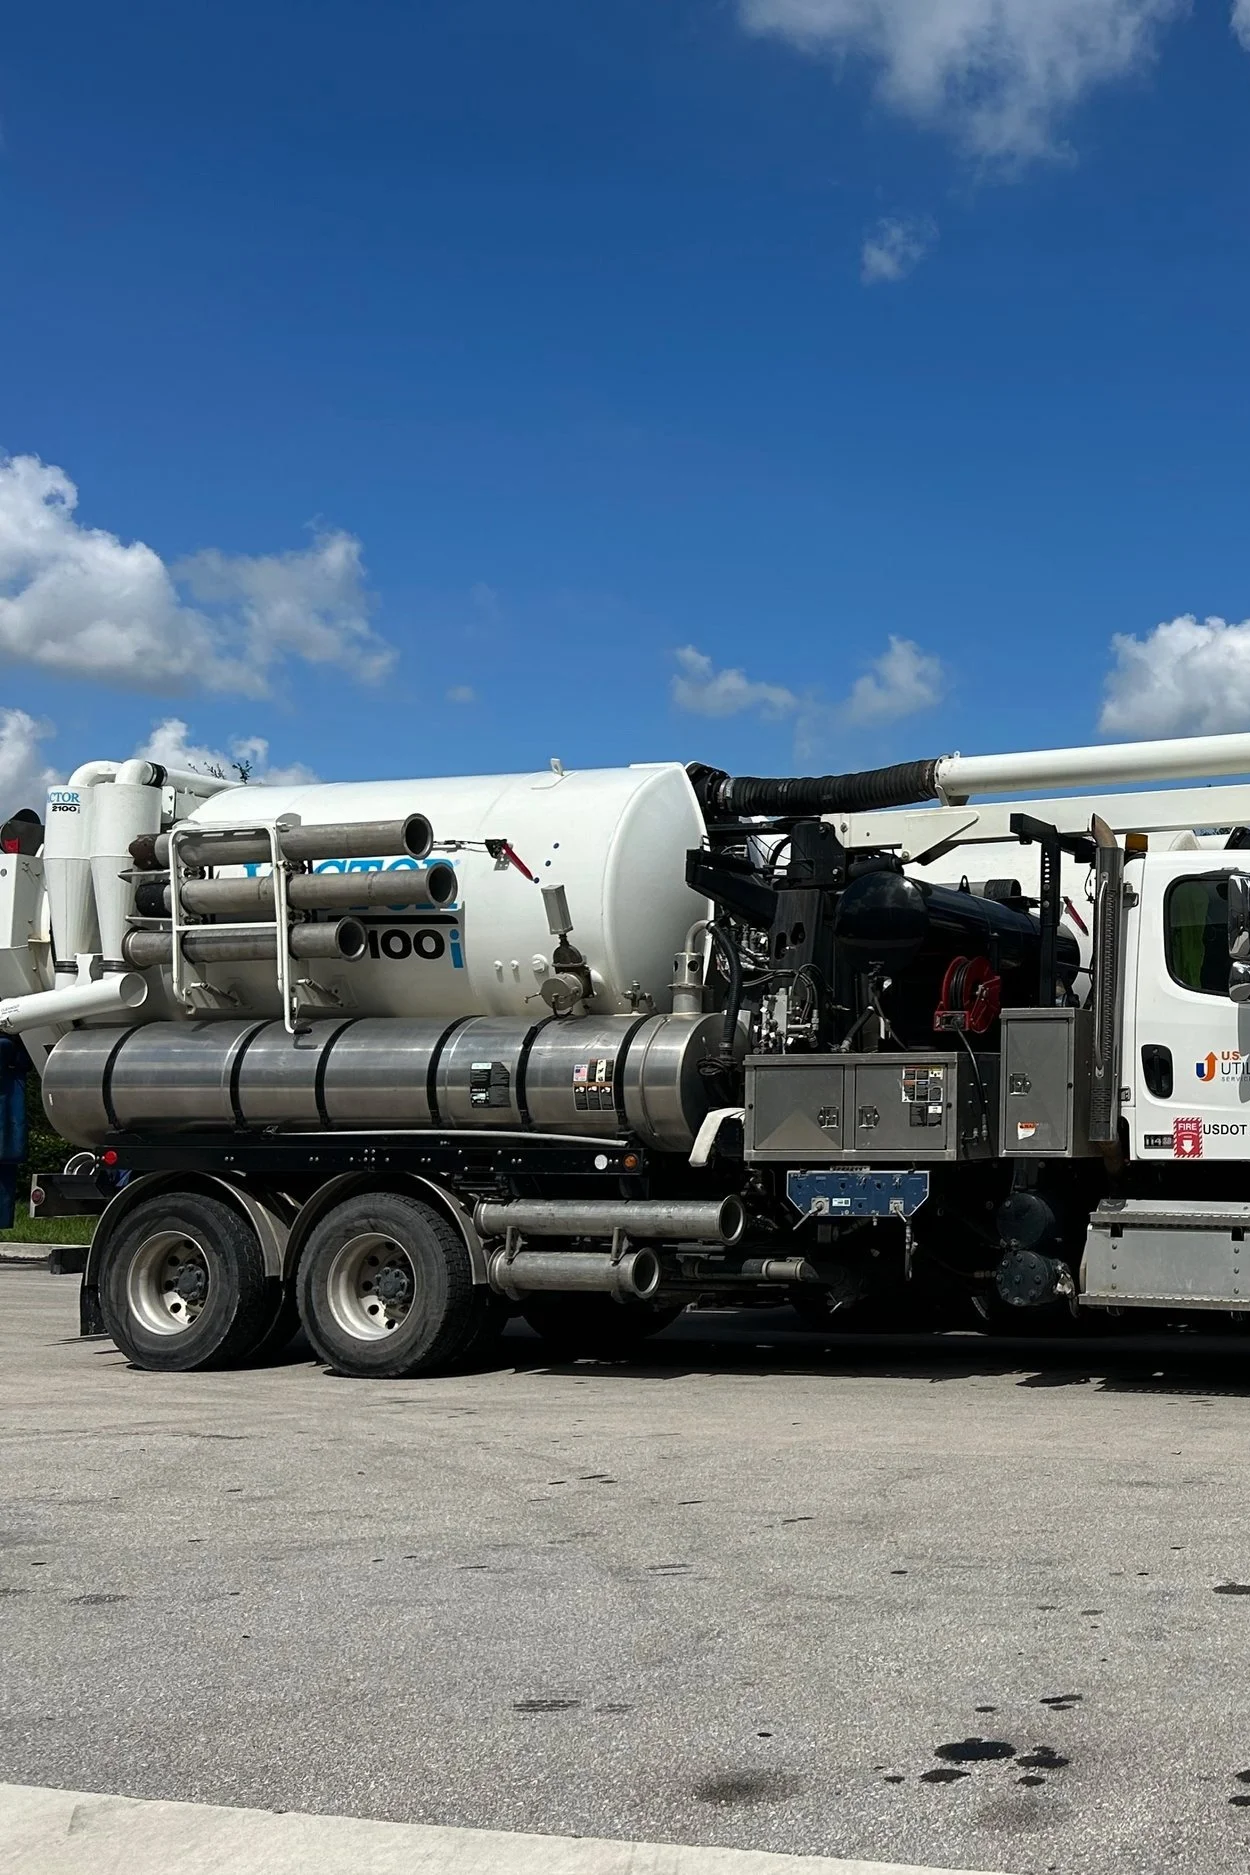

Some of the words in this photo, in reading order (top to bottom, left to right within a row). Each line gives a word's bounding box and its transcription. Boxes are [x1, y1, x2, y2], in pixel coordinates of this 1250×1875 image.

[366, 928, 464, 968] 100i
[1221, 1051, 1242, 1060] U.S.
[1178, 1122, 1197, 1131] FIRE
[1203, 1124, 1247, 1135] USDOT
